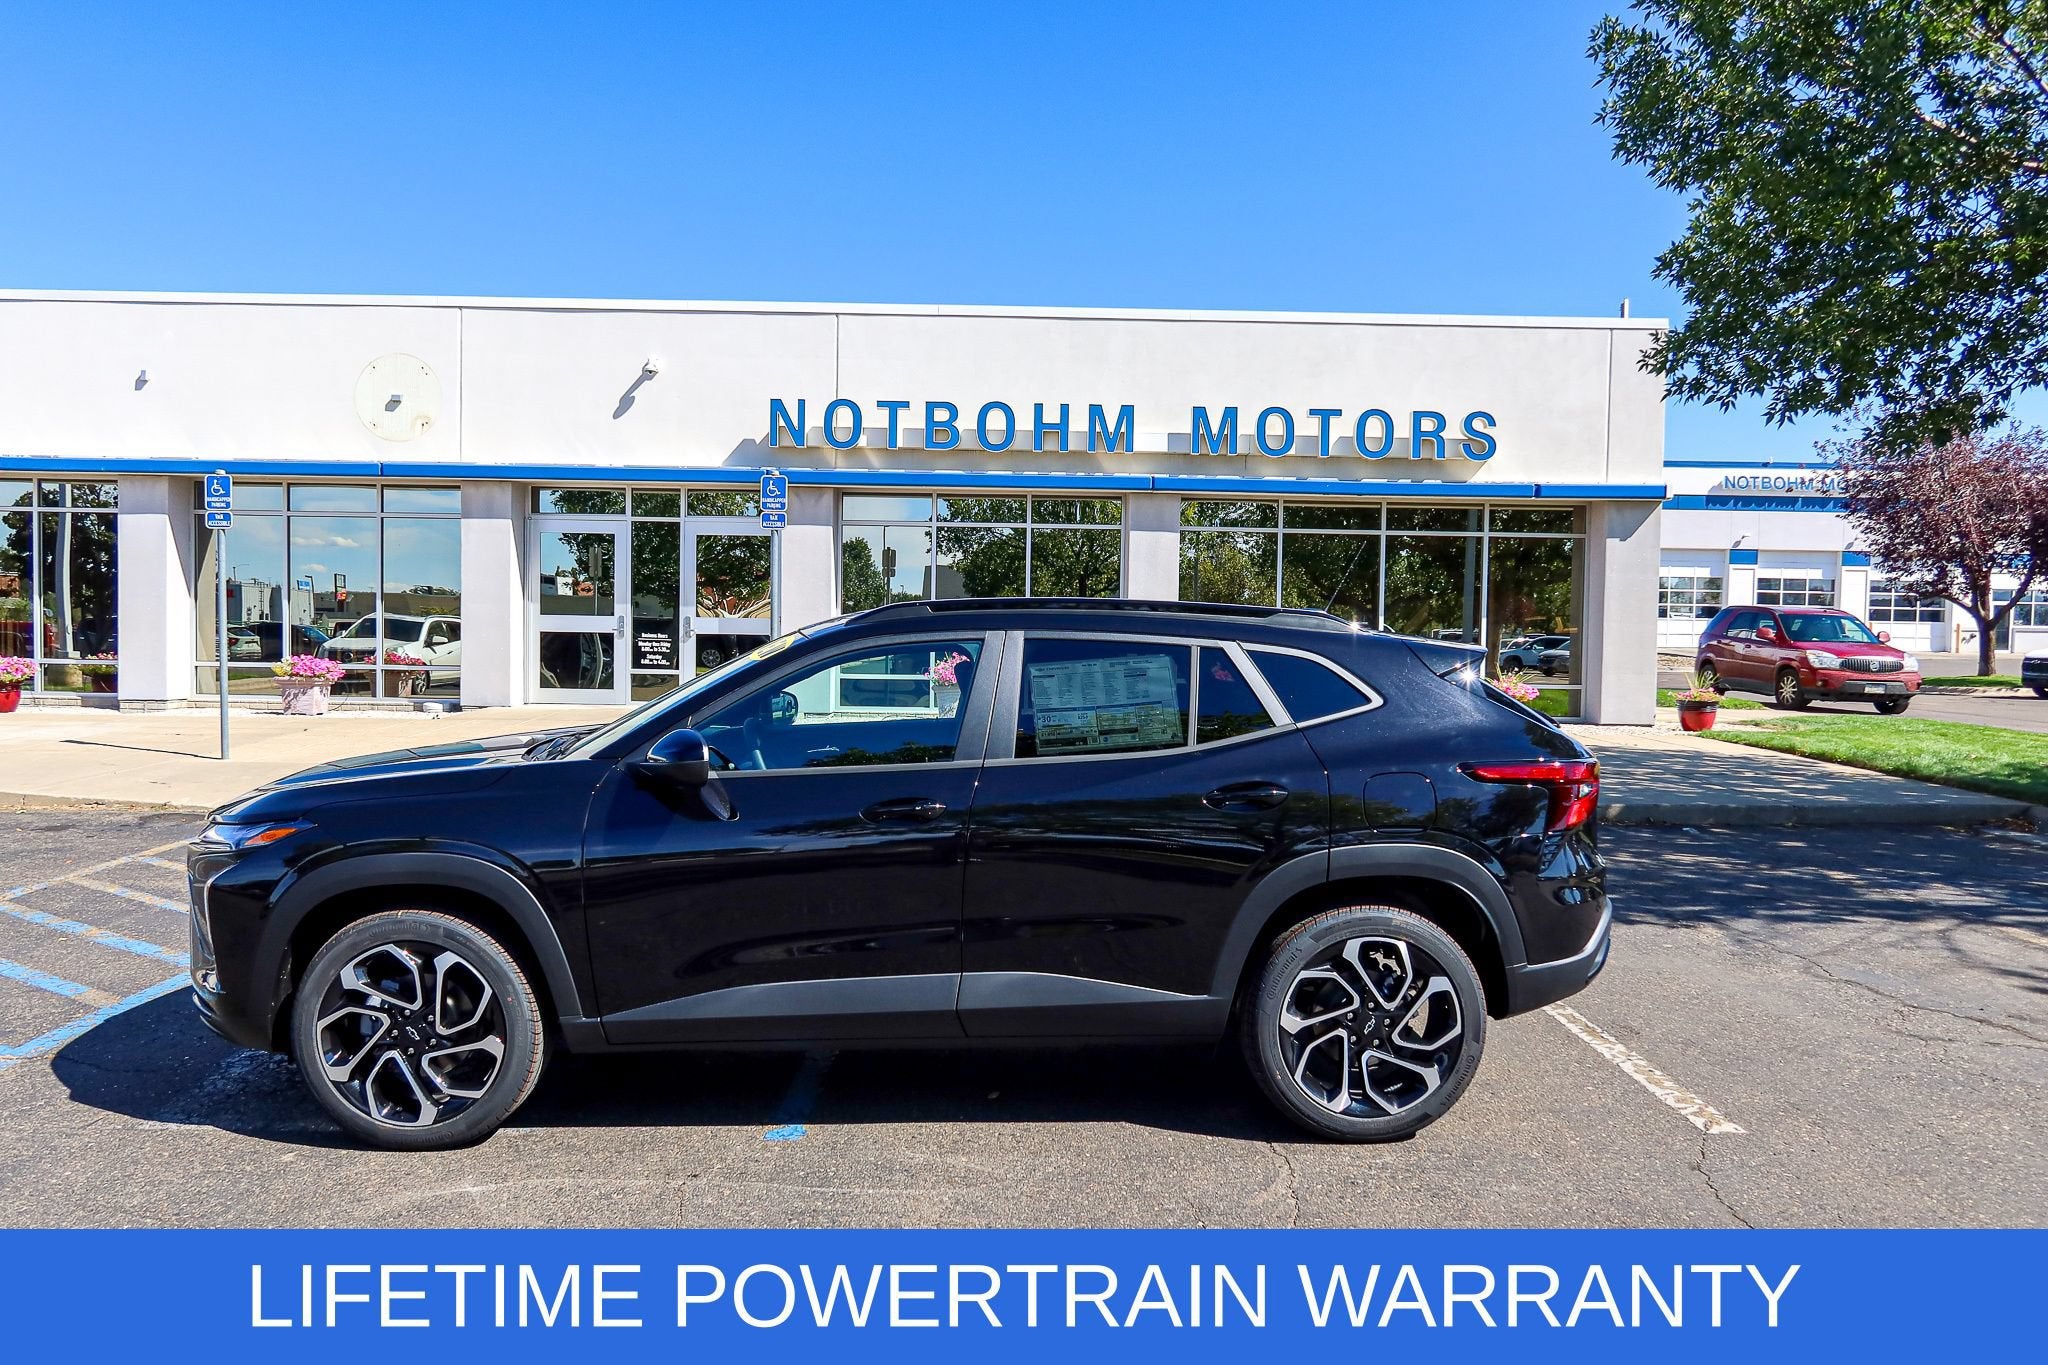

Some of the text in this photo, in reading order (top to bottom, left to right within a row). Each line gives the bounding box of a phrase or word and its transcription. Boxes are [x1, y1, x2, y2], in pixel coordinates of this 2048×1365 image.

[769, 398, 1497, 461] NOTBOHM MOTORS
[1724, 475, 1814, 490] NOTBOHM
